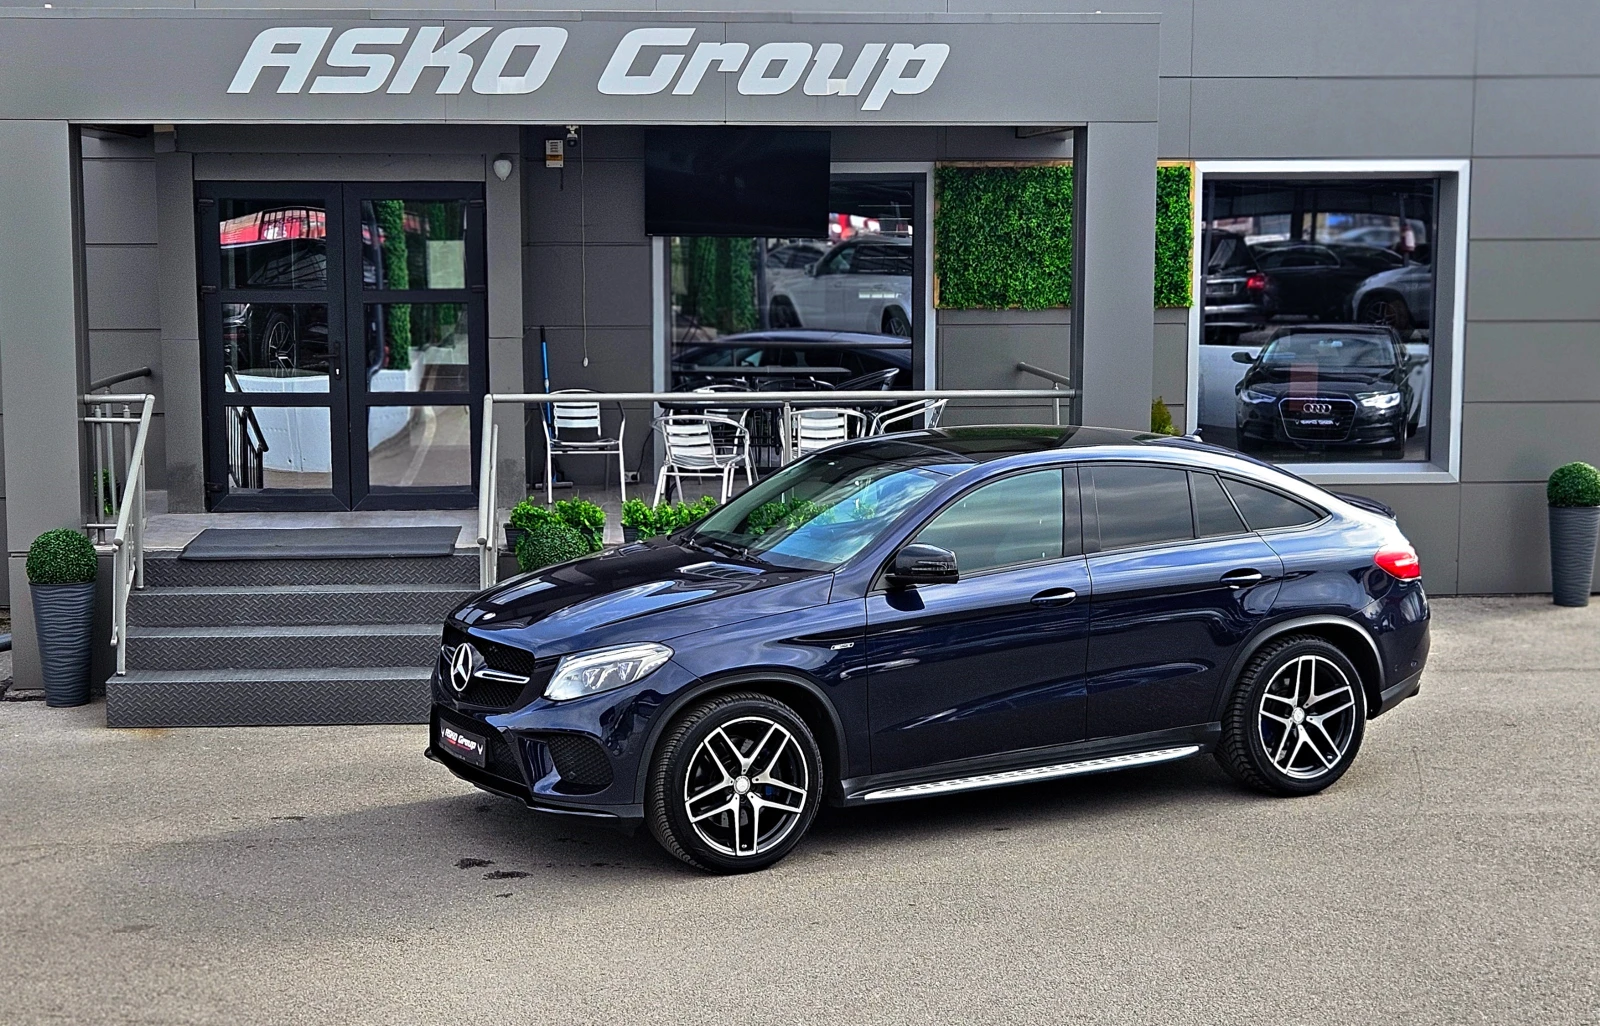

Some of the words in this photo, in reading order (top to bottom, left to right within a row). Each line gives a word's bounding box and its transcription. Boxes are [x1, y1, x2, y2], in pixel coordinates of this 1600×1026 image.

[226, 27, 568, 95] ASKO
[597, 27, 951, 111] Group
[458, 735, 477, 750] Group
